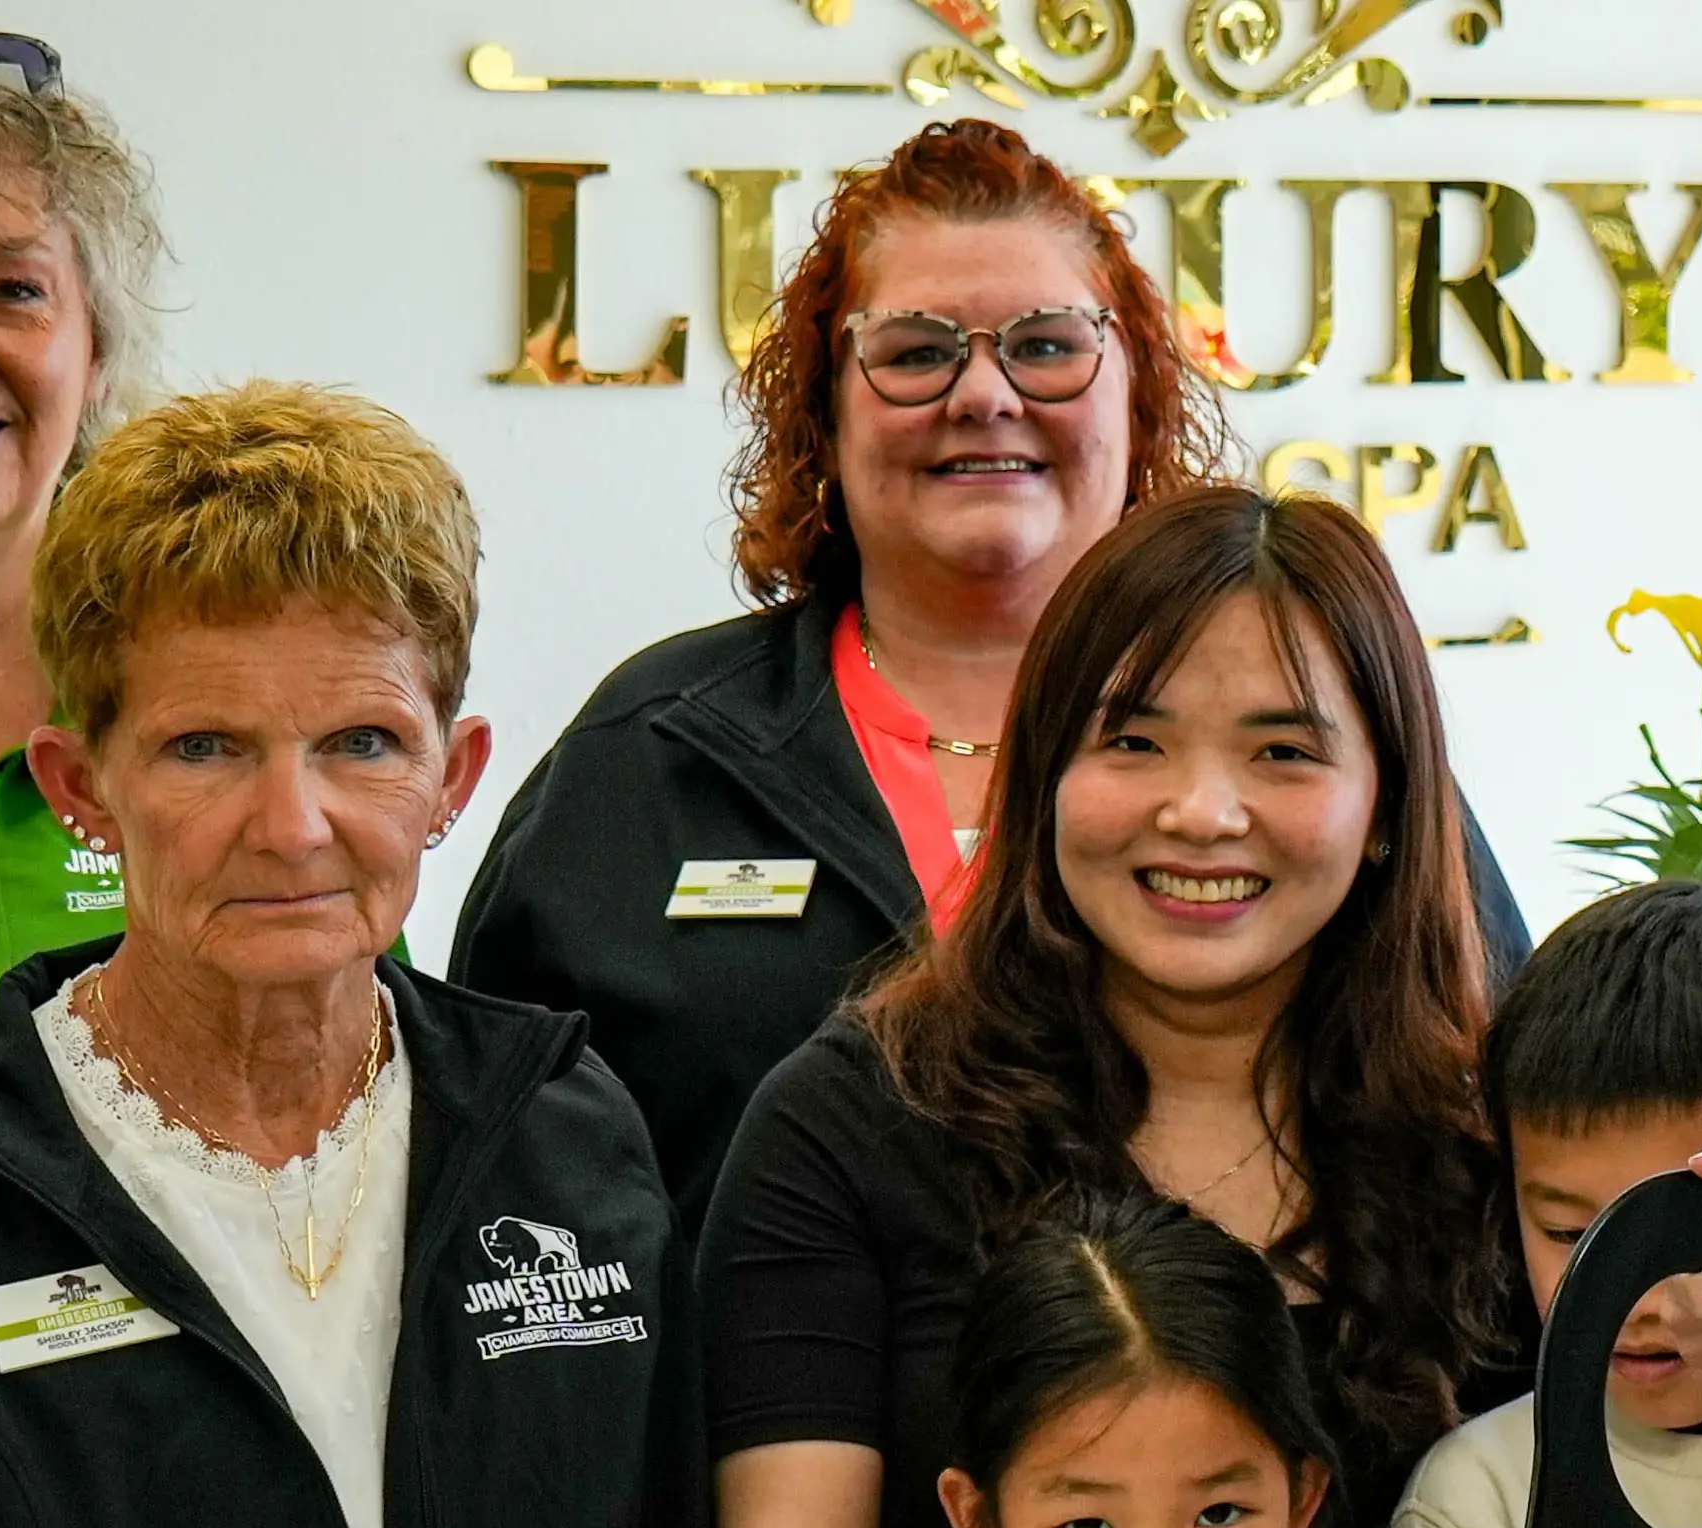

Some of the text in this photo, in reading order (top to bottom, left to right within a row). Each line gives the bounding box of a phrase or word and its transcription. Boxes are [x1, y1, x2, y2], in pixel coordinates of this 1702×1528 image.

[64, 849, 122, 874] JAM
[464, 1261, 632, 1314] JAMESTOWN
[524, 1302, 584, 1325] AREA
[37, 1317, 135, 1346] SHIRLEY JACKSON
[491, 1329, 549, 1351] CHAMBER
[562, 1321, 631, 1340] COMMERCE
